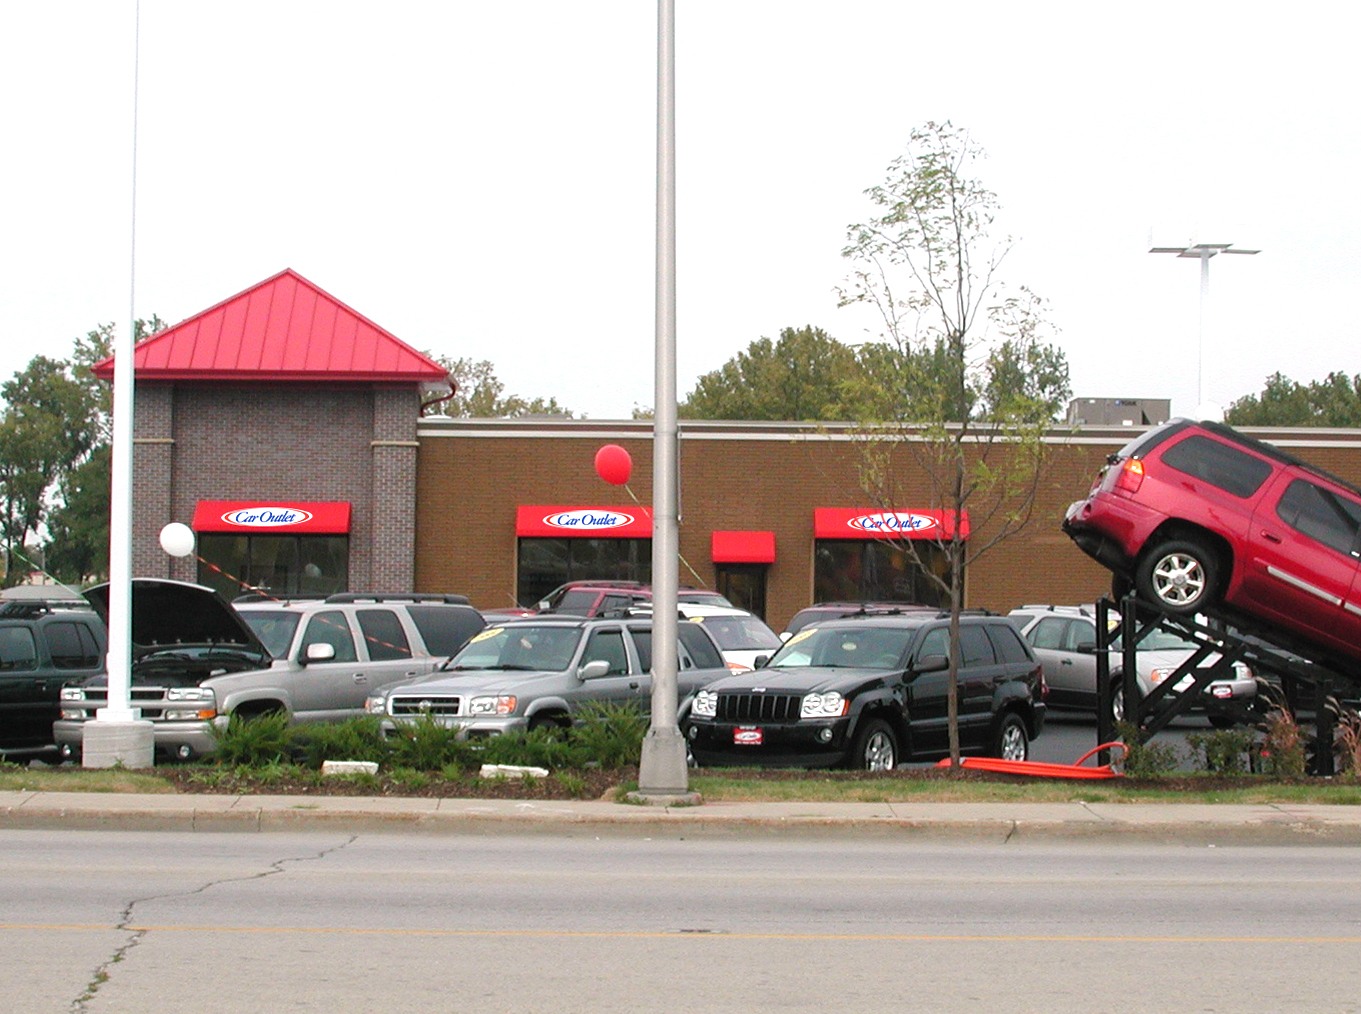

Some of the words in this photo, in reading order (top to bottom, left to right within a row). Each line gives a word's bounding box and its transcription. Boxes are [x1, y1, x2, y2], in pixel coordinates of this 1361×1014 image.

[235, 511, 258, 523] Car
[259, 510, 296, 523] Outlet
[557, 514, 580, 526] Car
[581, 513, 618, 526] Outlet
[861, 517, 884, 529] Car
[885, 516, 922, 529] Outlet
